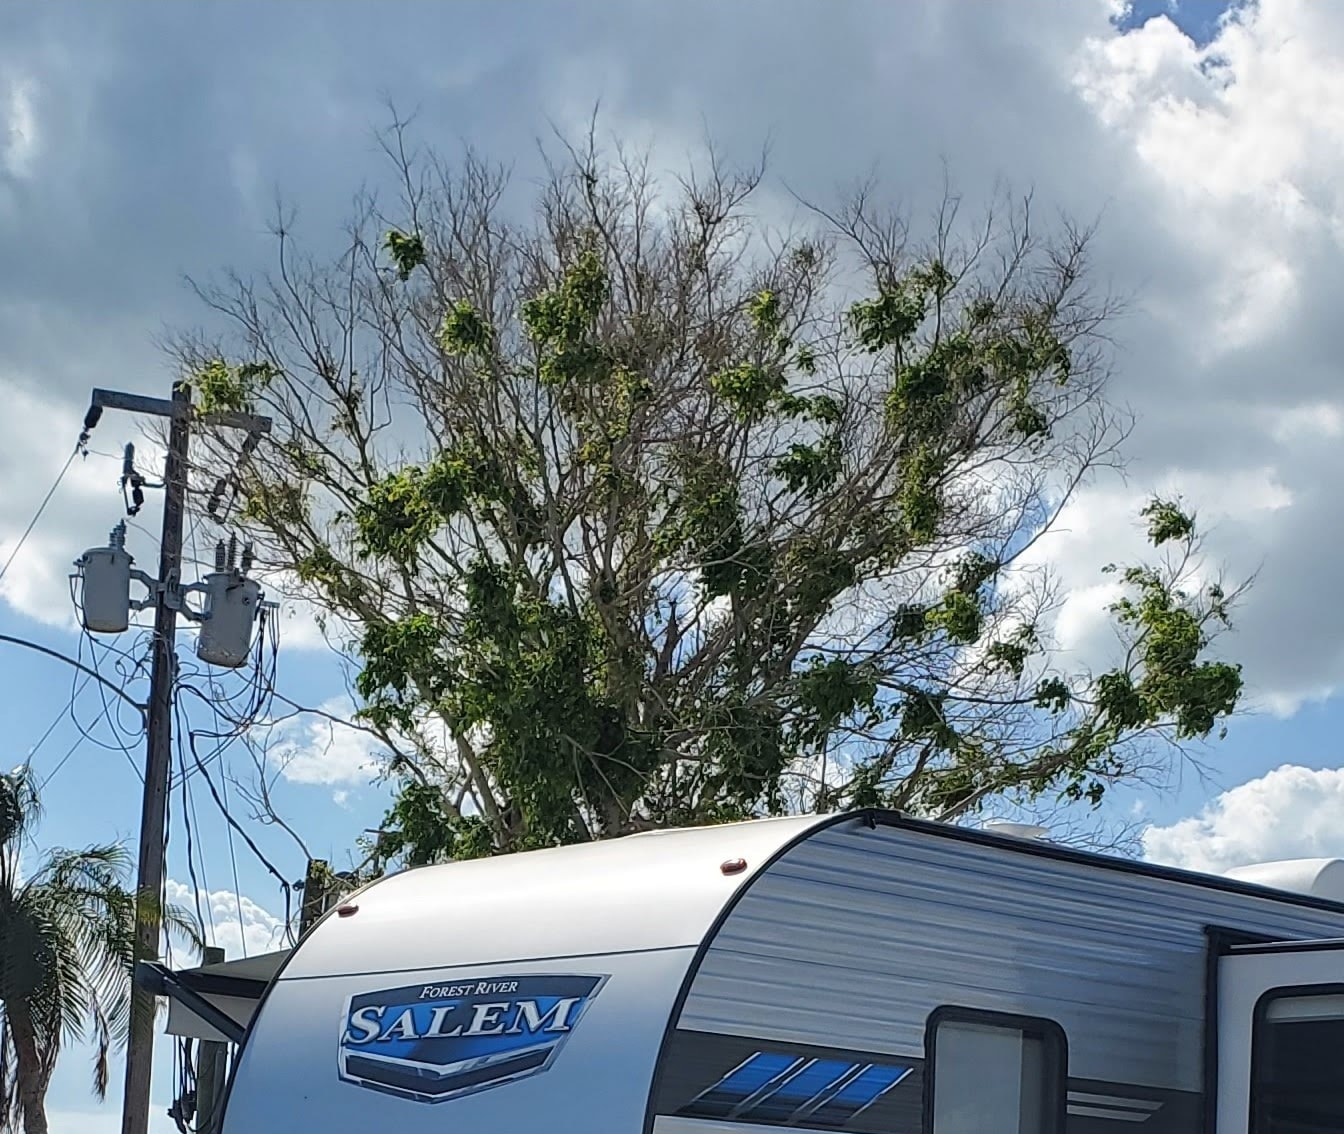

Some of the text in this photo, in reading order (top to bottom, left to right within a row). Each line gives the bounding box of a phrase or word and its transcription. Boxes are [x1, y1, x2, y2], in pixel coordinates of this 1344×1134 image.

[419, 981, 518, 999] FOREST RIVER
[344, 998, 580, 1044] SALEM
